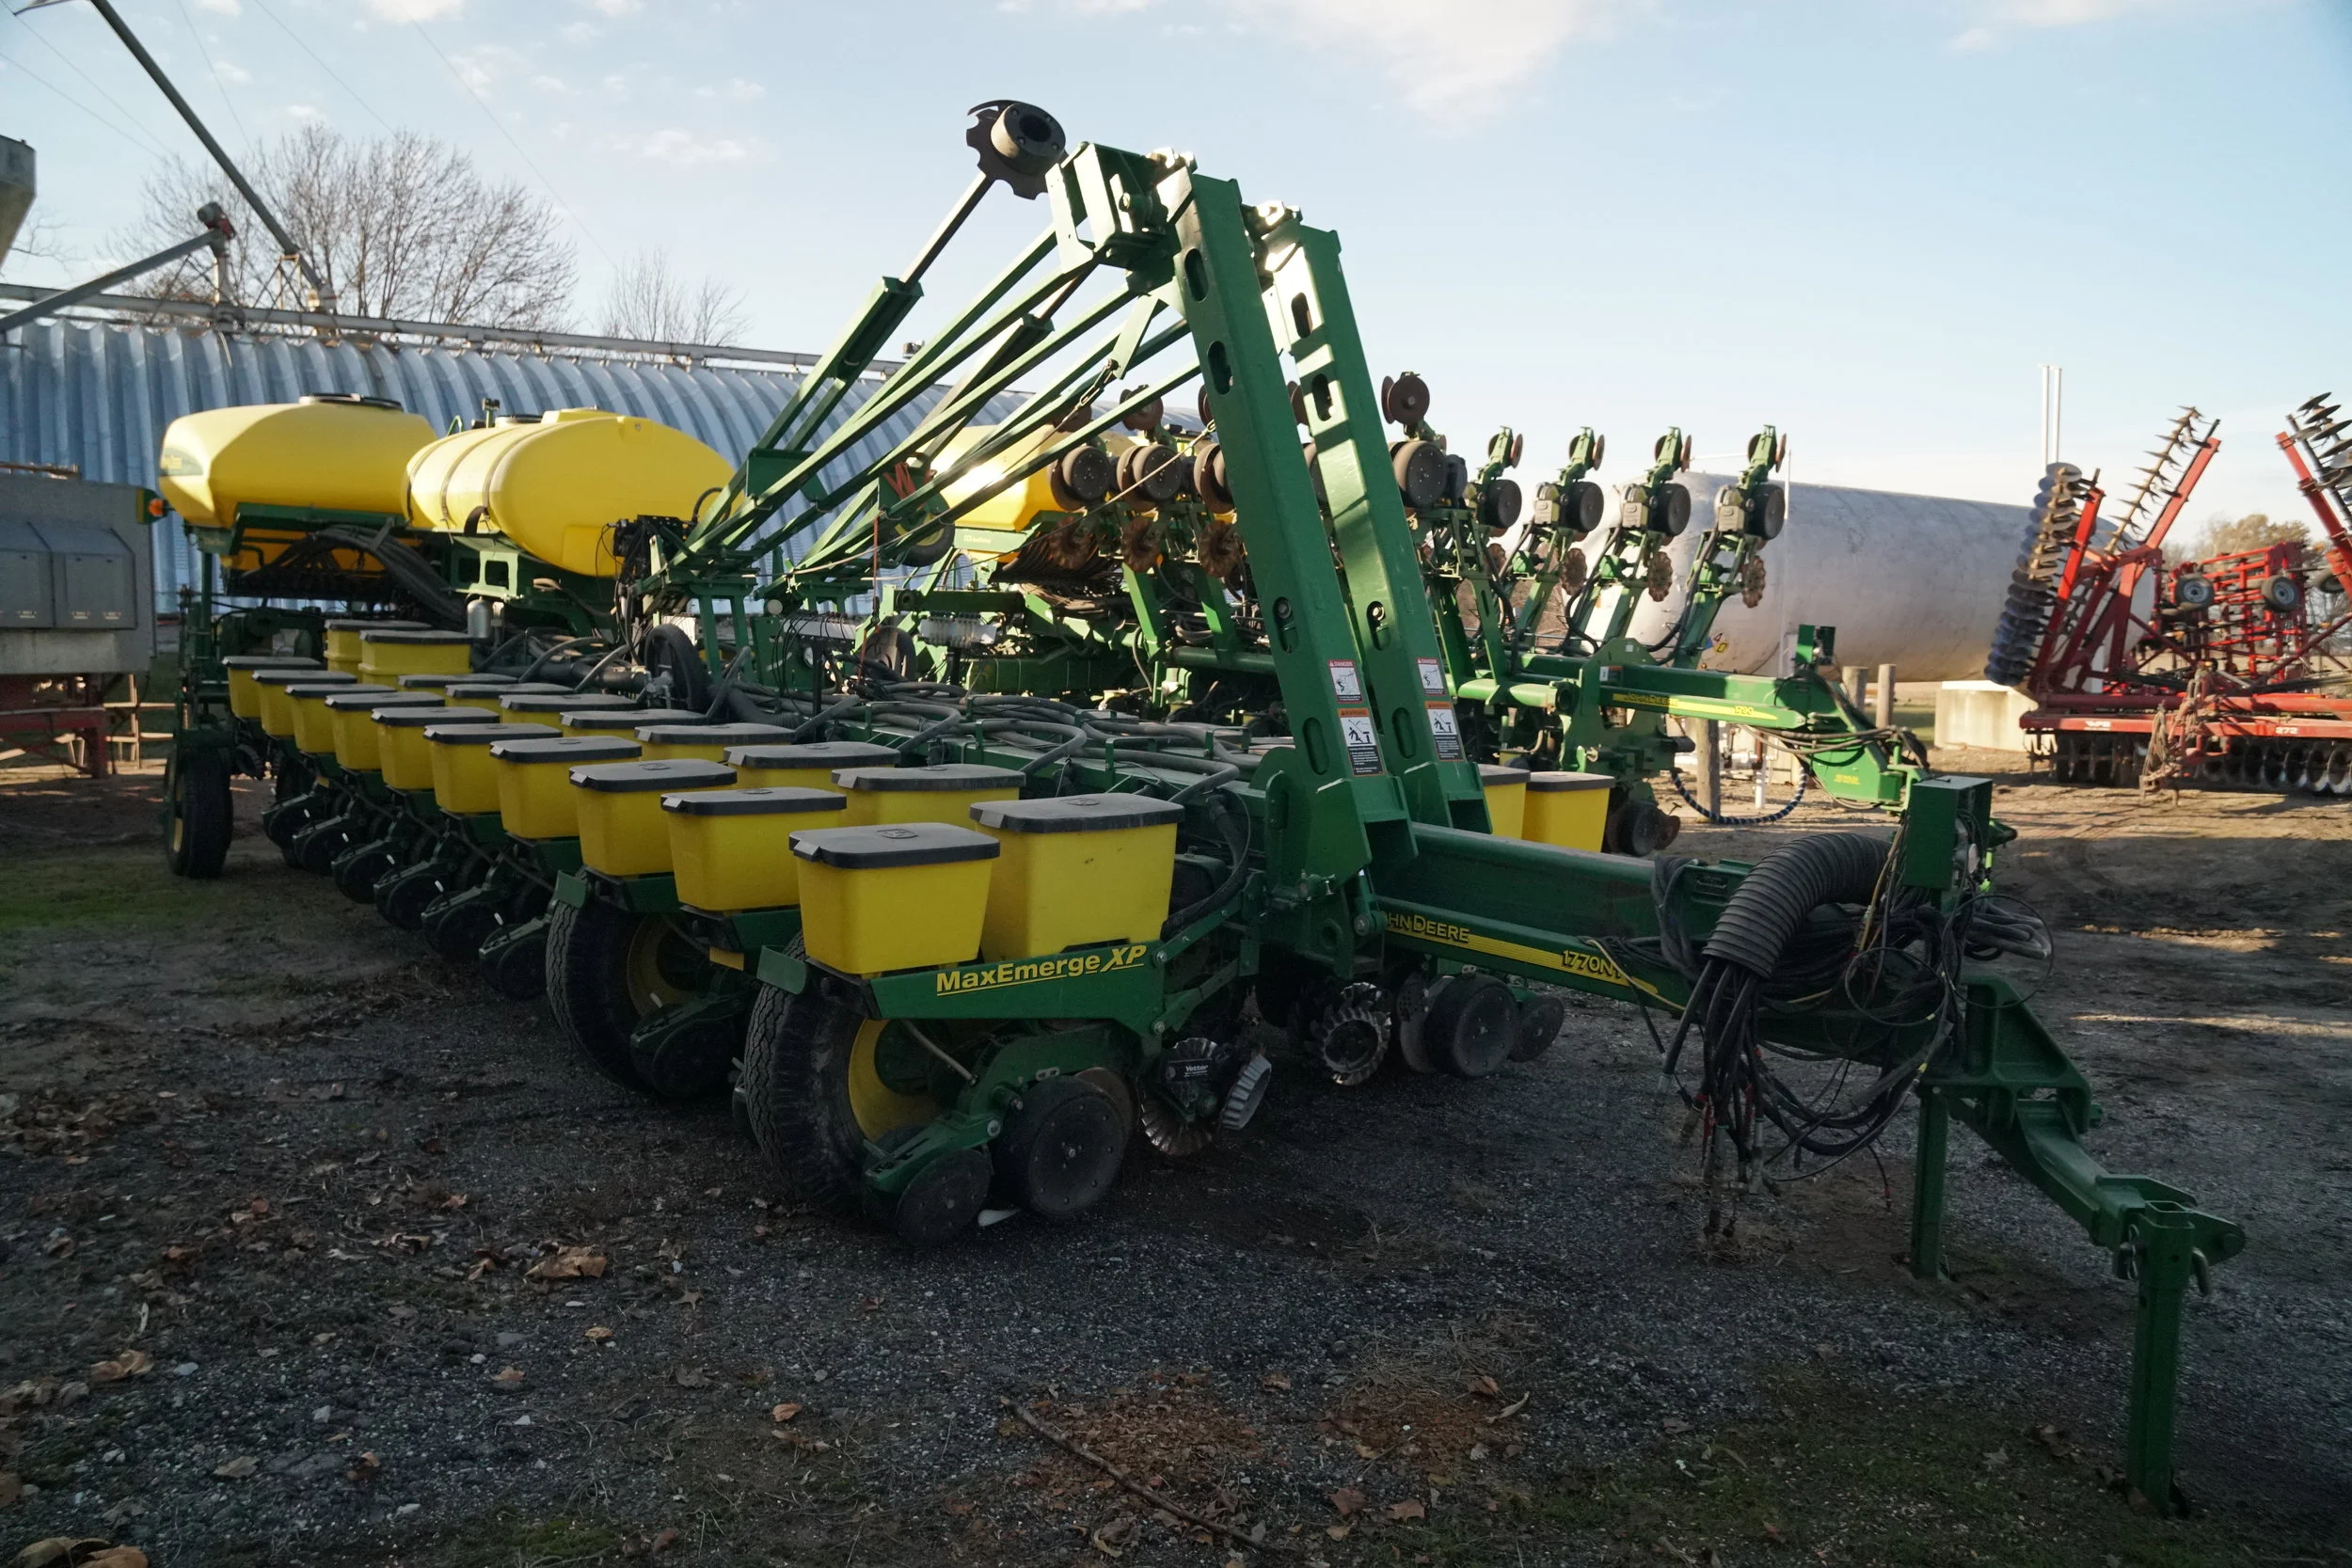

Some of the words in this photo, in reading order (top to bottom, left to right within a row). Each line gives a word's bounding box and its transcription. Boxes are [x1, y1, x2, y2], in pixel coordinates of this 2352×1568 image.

[1385, 911, 1411, 930] HN
[1413, 914, 1470, 942] DEERE
[937, 955, 1100, 992] MaxEmerge
[1100, 944, 1147, 973] XP
